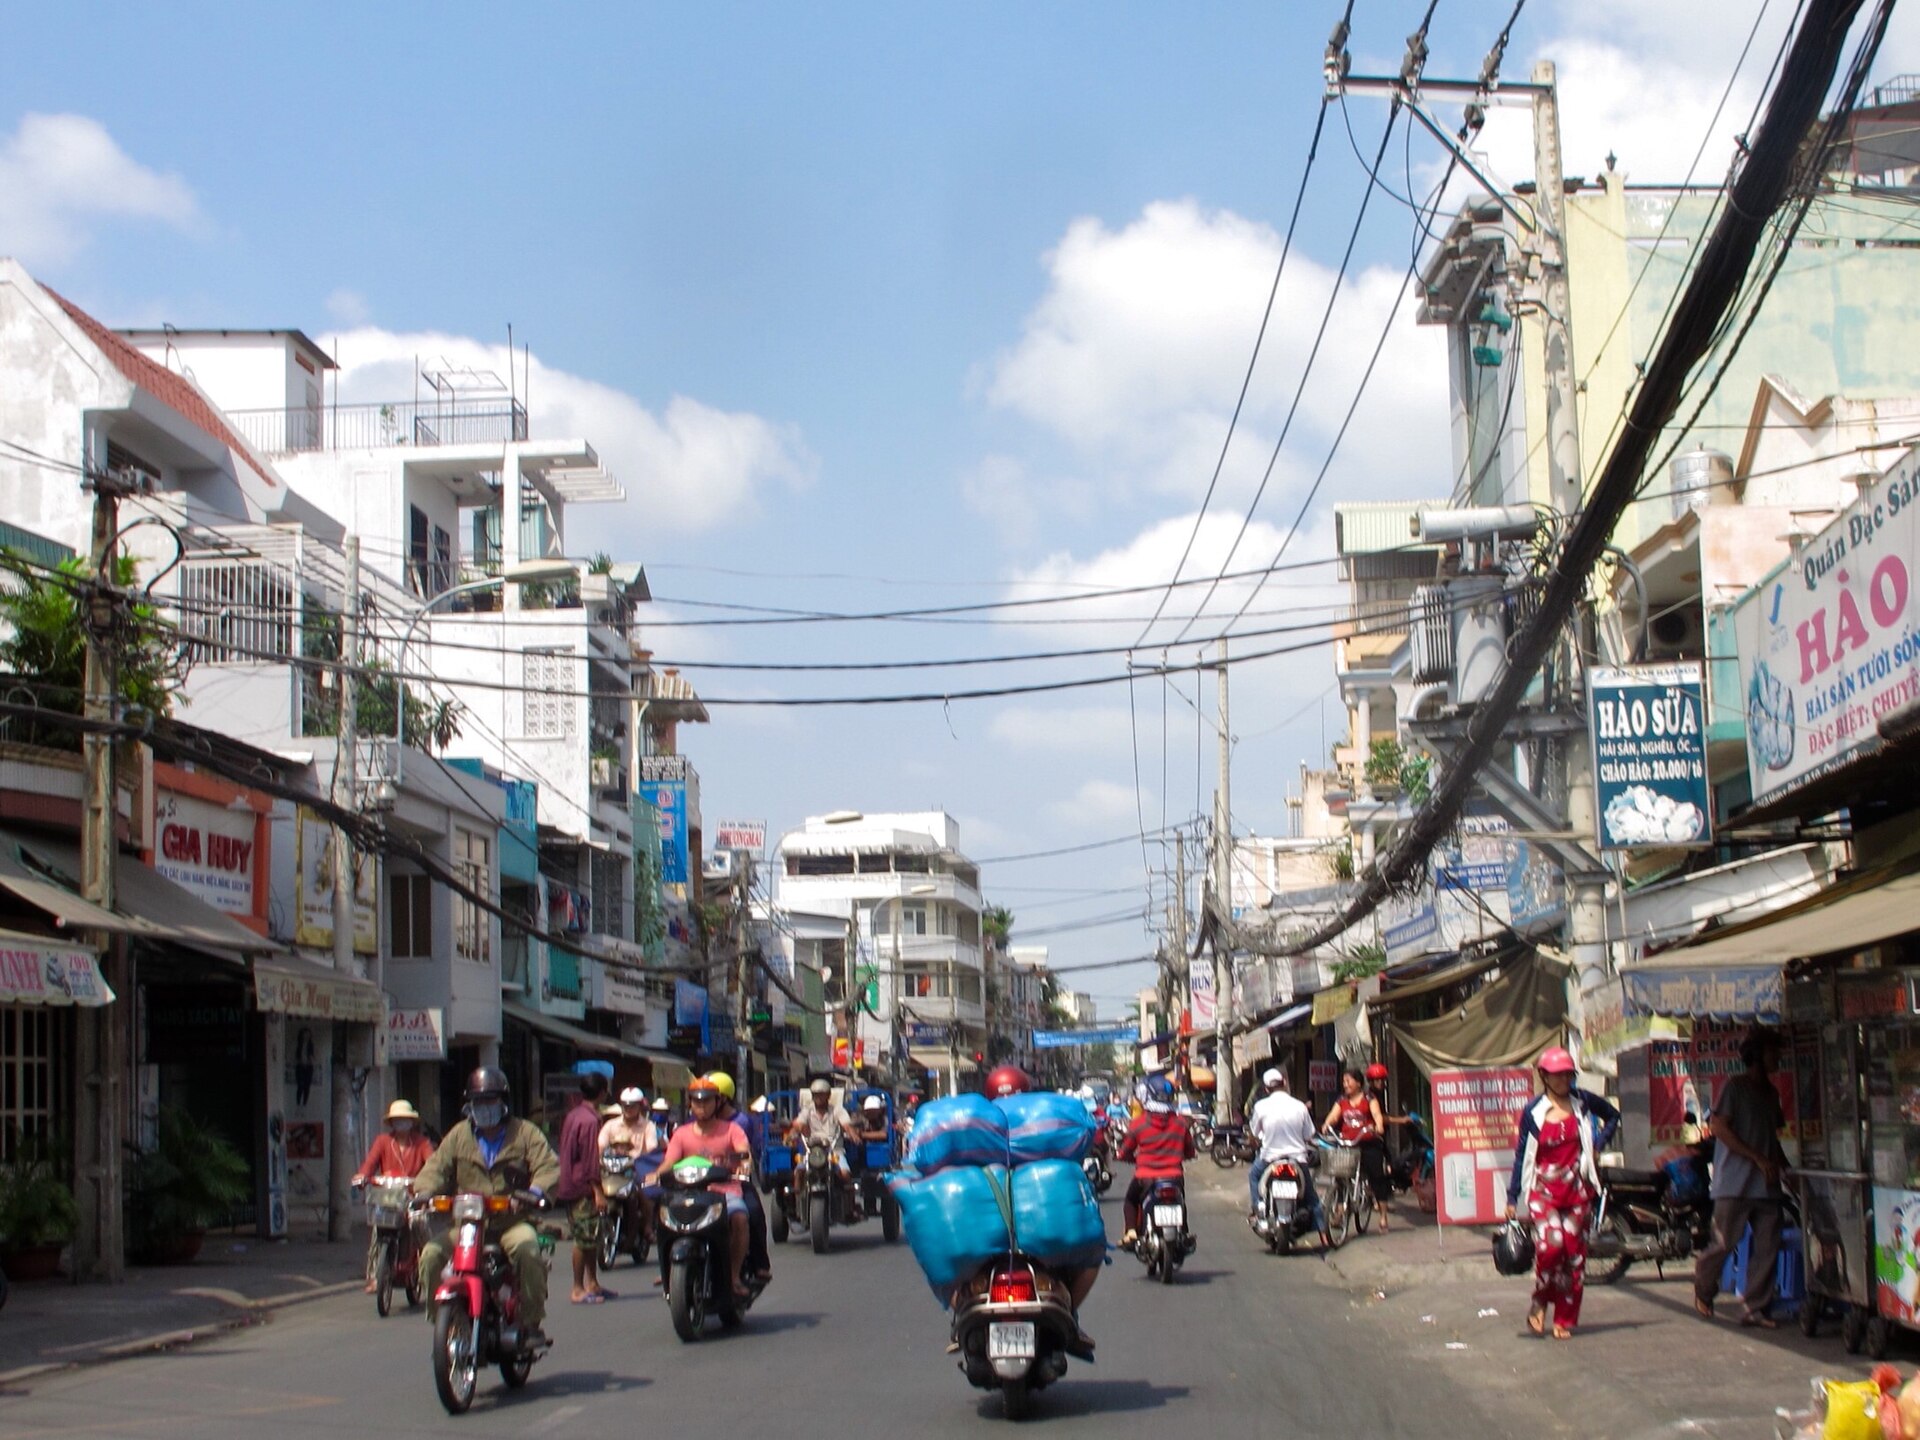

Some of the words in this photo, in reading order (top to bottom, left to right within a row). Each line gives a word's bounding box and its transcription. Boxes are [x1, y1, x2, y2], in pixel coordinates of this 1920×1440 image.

[1804, 538, 1846, 592] Quán
[1848, 504, 1884, 549] Đặc
[1796, 555, 1909, 686] HÀO
[1829, 669, 1856, 708] SẢN
[1597, 689, 1647, 739] HÀO
[1651, 687, 1698, 737] SỮA
[1599, 739, 1617, 757] HẢI
[1617, 739, 1640, 757] SẢN,
[1600, 758, 1628, 783] CHÁO
[1628, 757, 1652, 781] HÀO:
[162, 822, 202, 865] GIA
[206, 831, 252, 874] HUY
[1437, 1081, 1457, 1096] CHO
[1439, 1098, 1470, 1114] THANH
